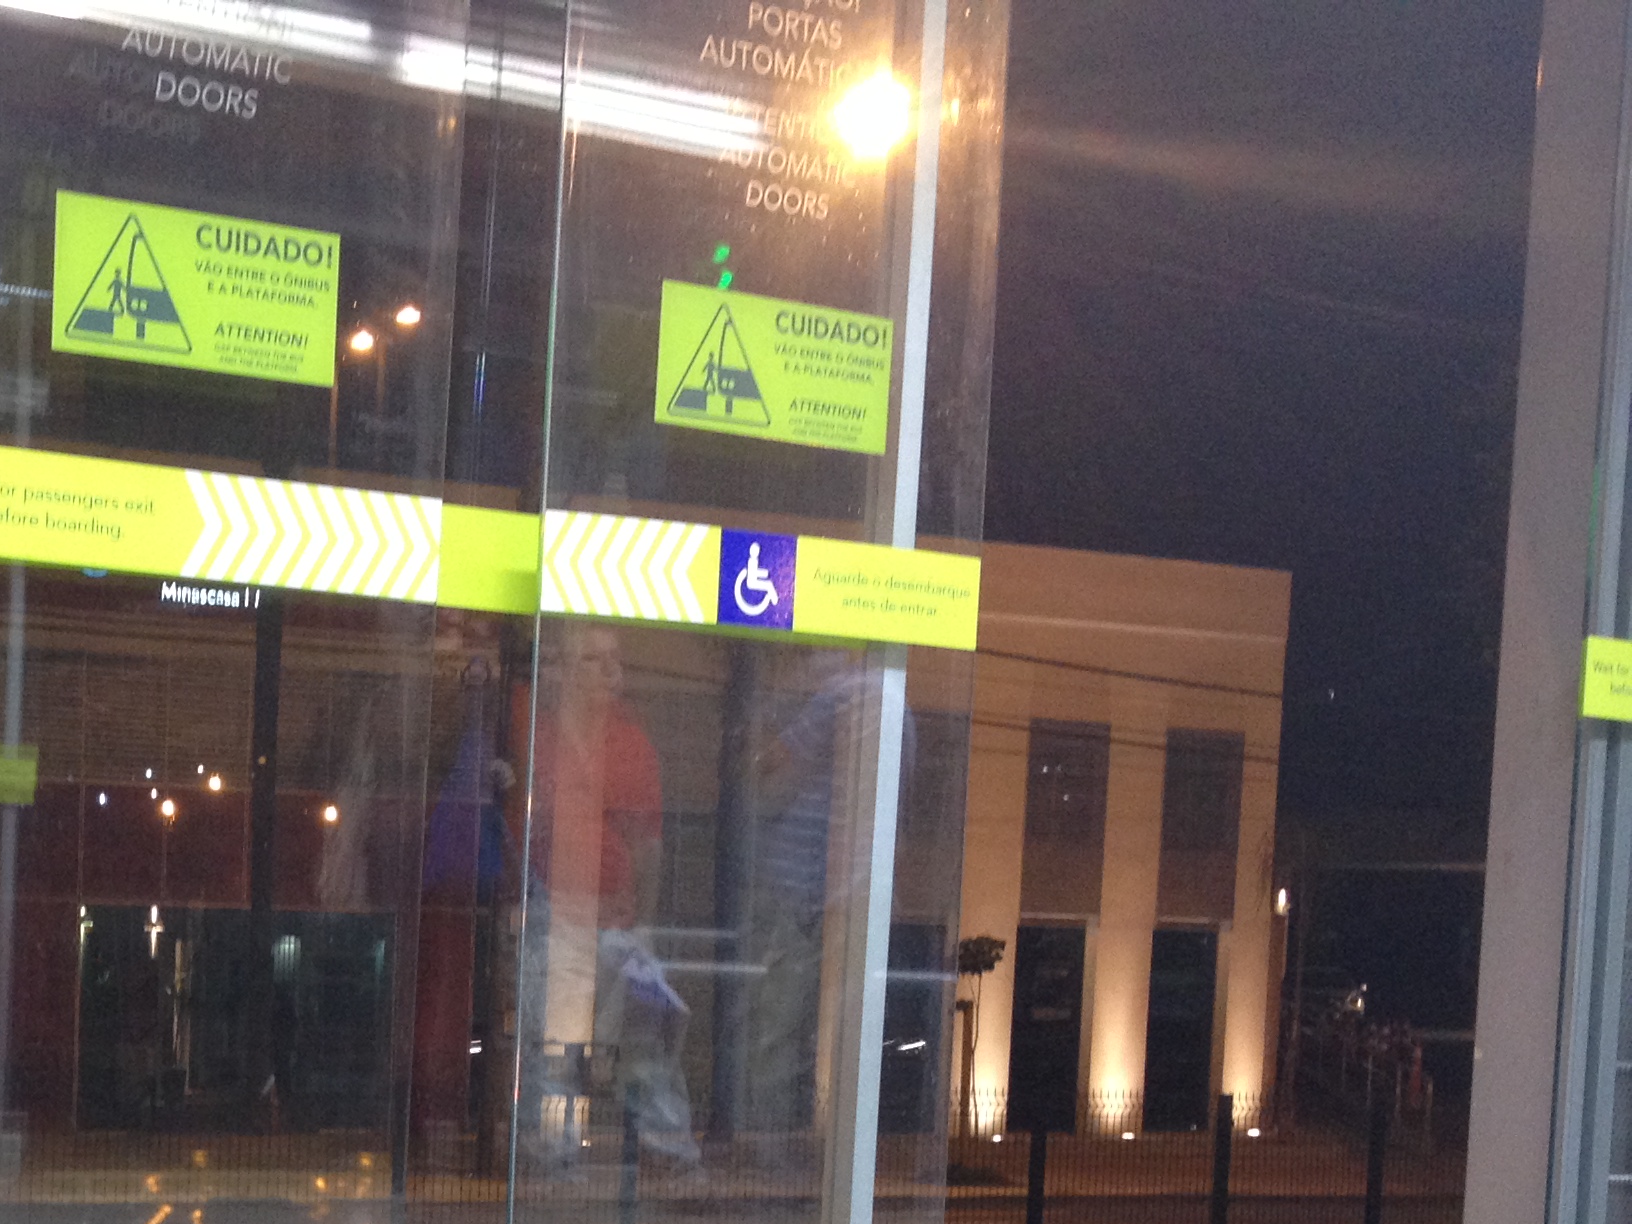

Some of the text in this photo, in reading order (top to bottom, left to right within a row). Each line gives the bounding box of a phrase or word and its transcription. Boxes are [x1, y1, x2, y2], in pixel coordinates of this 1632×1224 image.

[748, 1, 843, 50] PORTAS
[121, 27, 293, 84] AUTOMATIC
[699, 34, 848, 87] AUTOMÁTIC
[154, 70, 259, 120] DOORS
[745, 179, 830, 220] DOORS
[196, 222, 333, 269] CUIDADO!
[214, 321, 309, 350] ATTENTION!
[775, 309, 887, 350] CUIDADO!
[23, 486, 119, 510] passengers
[125, 499, 154, 515] exit
[813, 567, 869, 586] Aguarde
[842, 597, 876, 611] antes
[880, 598, 896, 612] de
